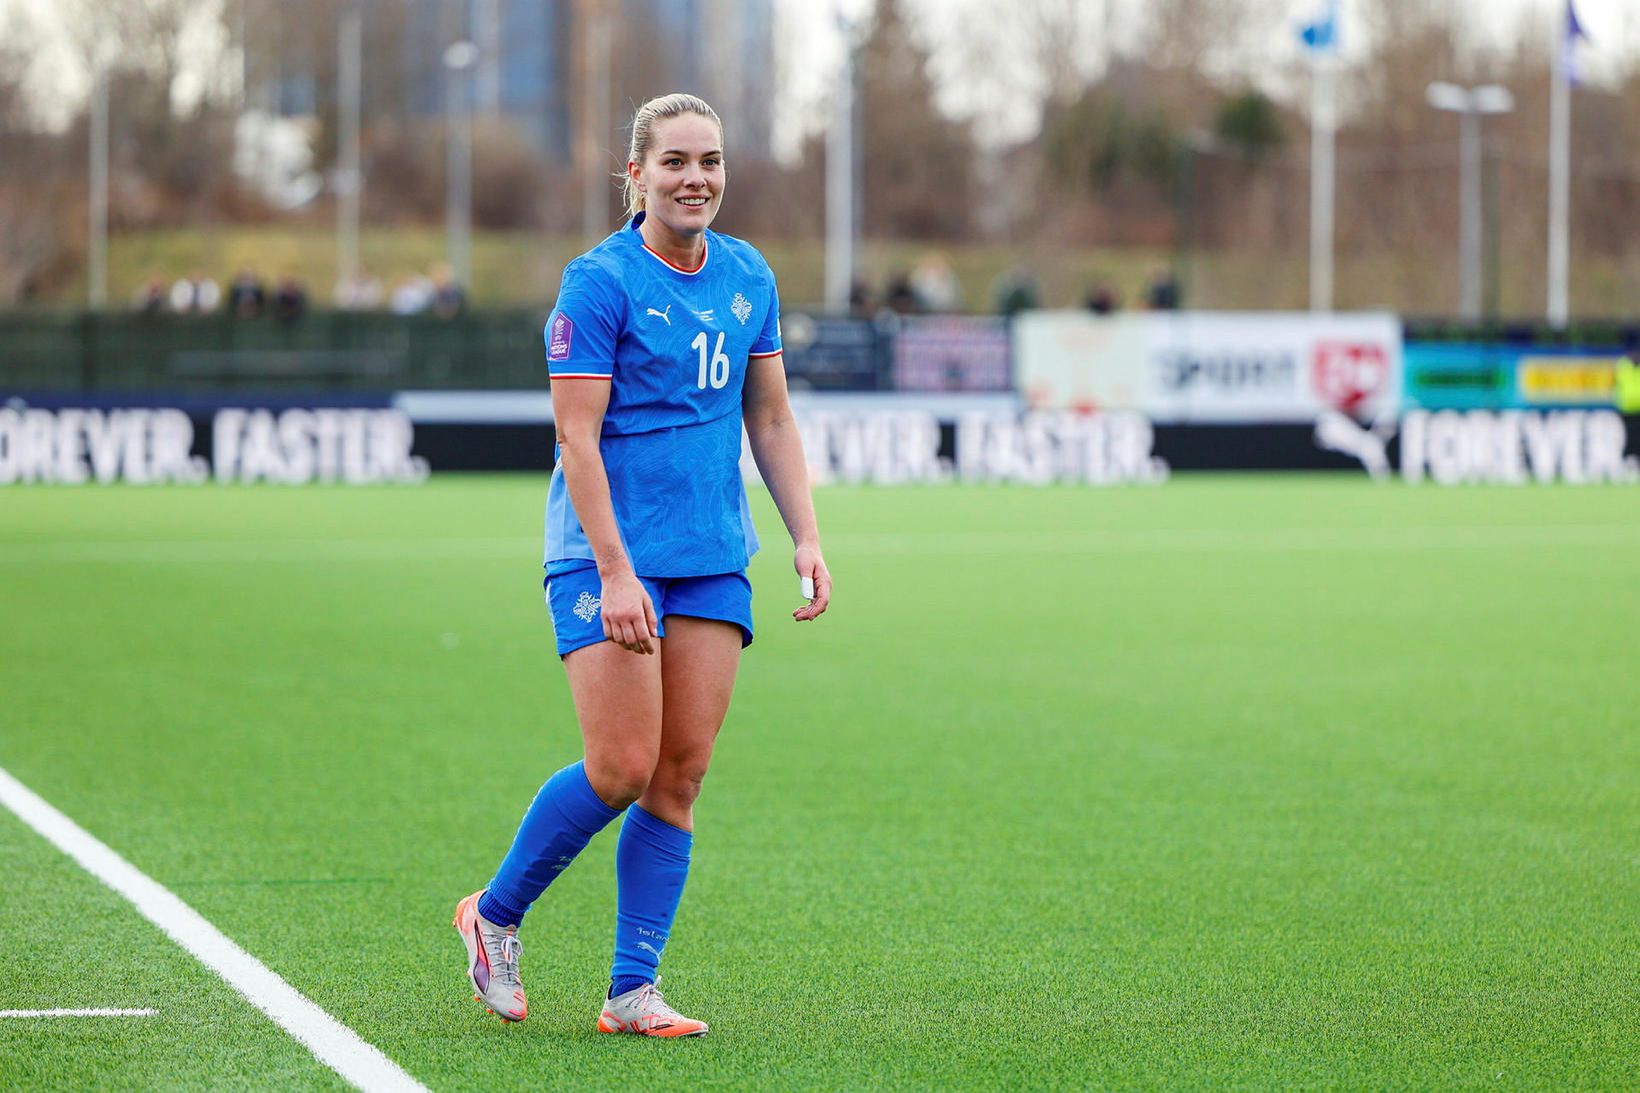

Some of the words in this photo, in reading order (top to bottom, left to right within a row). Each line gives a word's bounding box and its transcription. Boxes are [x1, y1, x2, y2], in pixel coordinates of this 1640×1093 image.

[691, 331, 730, 390] 16
[213, 407, 431, 485] FASTER.
[957, 410, 1169, 486] FASTER.
